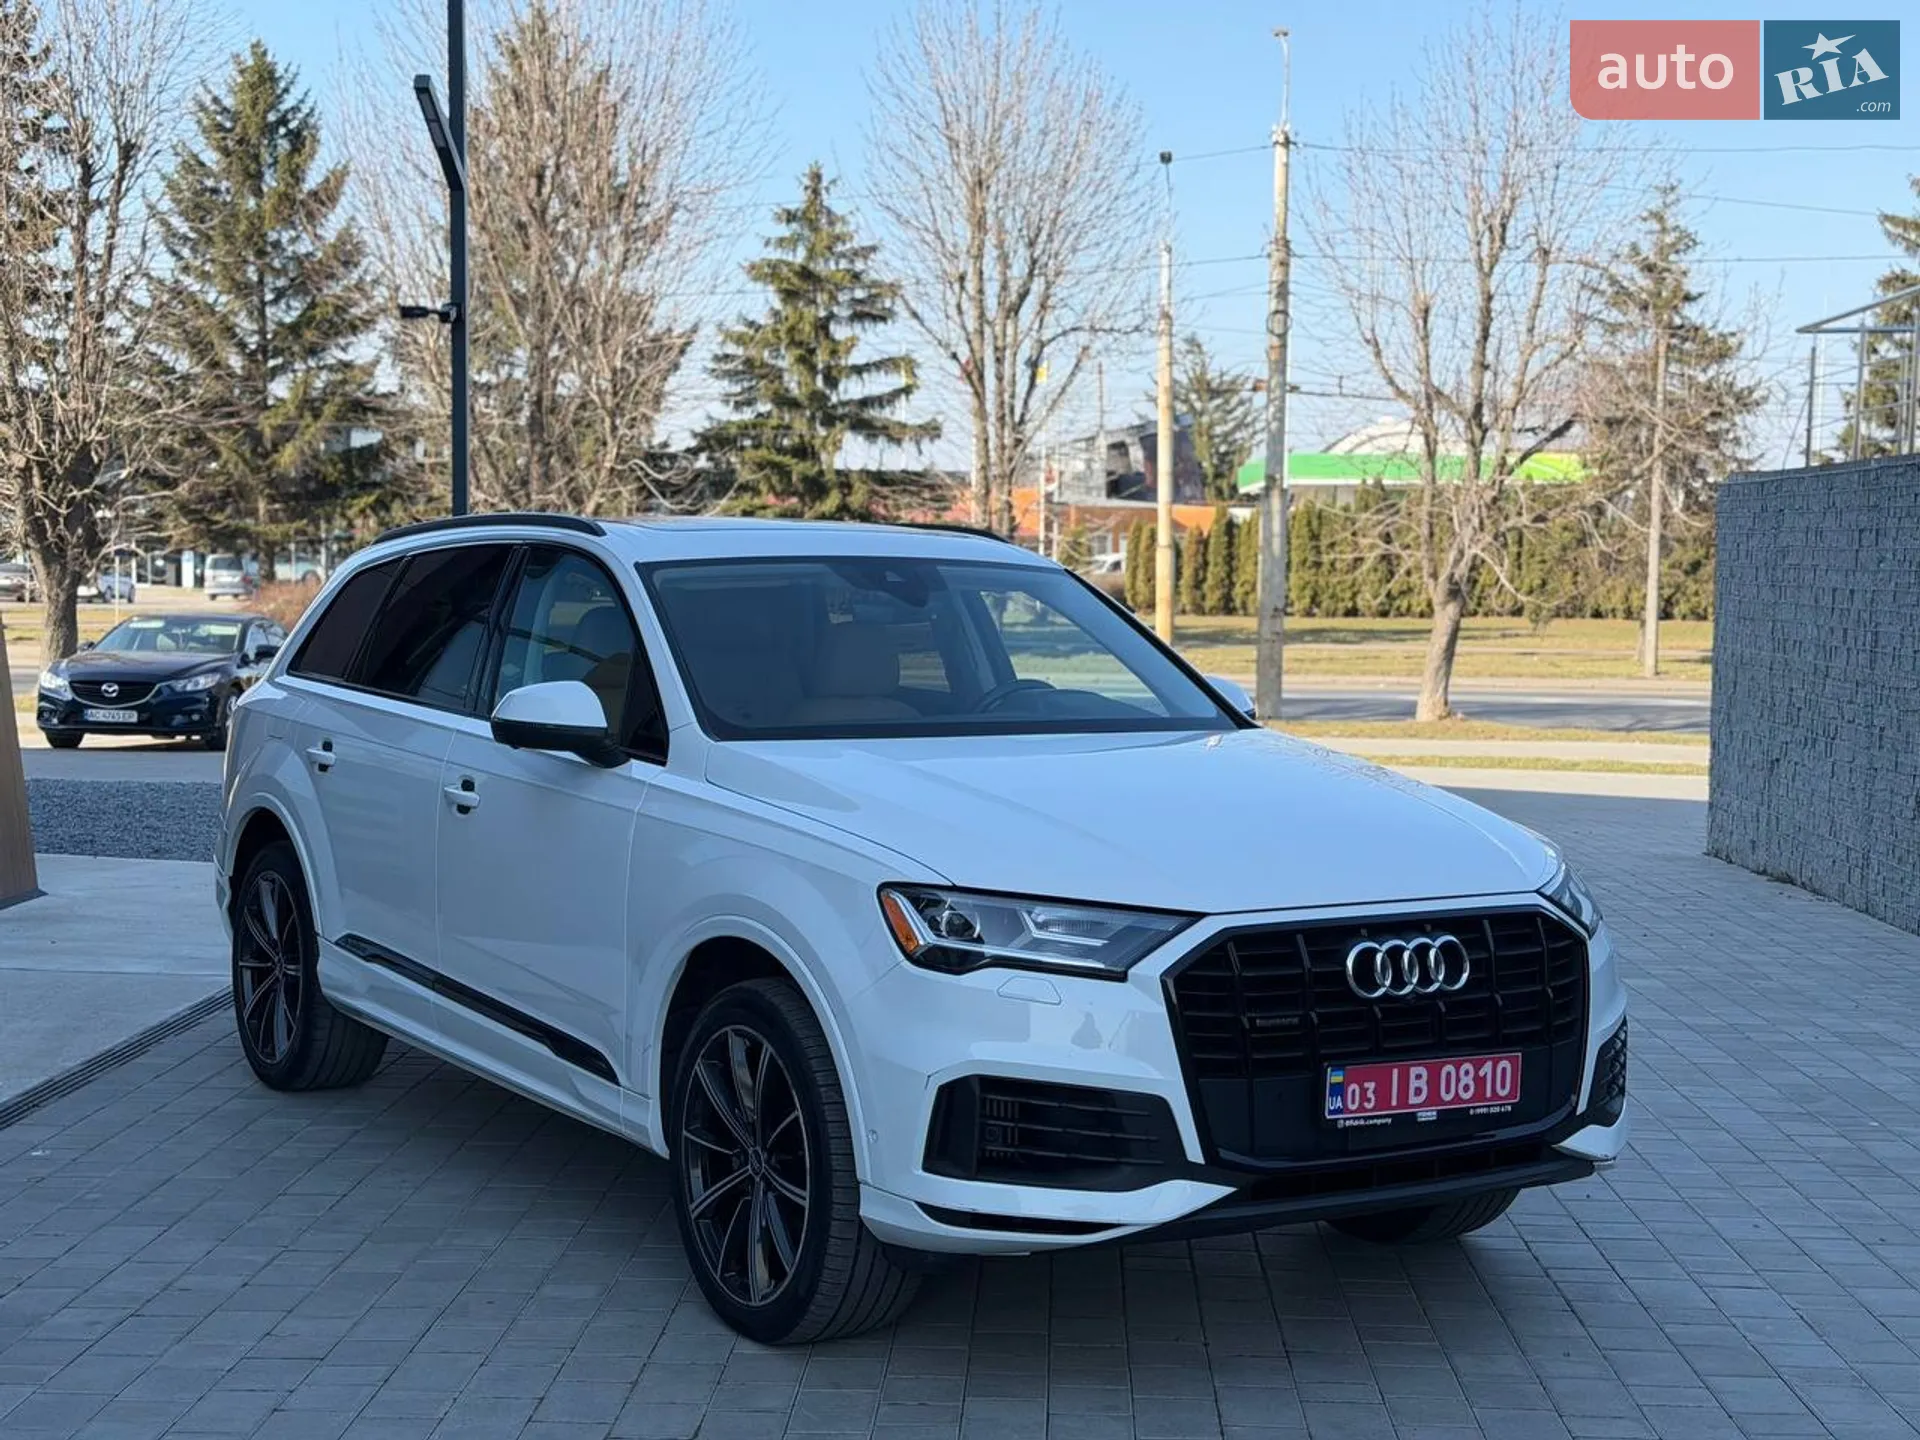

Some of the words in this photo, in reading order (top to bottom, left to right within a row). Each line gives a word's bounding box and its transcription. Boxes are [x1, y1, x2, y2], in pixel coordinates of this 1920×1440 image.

[1347, 1081, 1376, 1111] 03
[1440, 1060, 1512, 1102] 0810
[1328, 1095, 1343, 1110] UA
